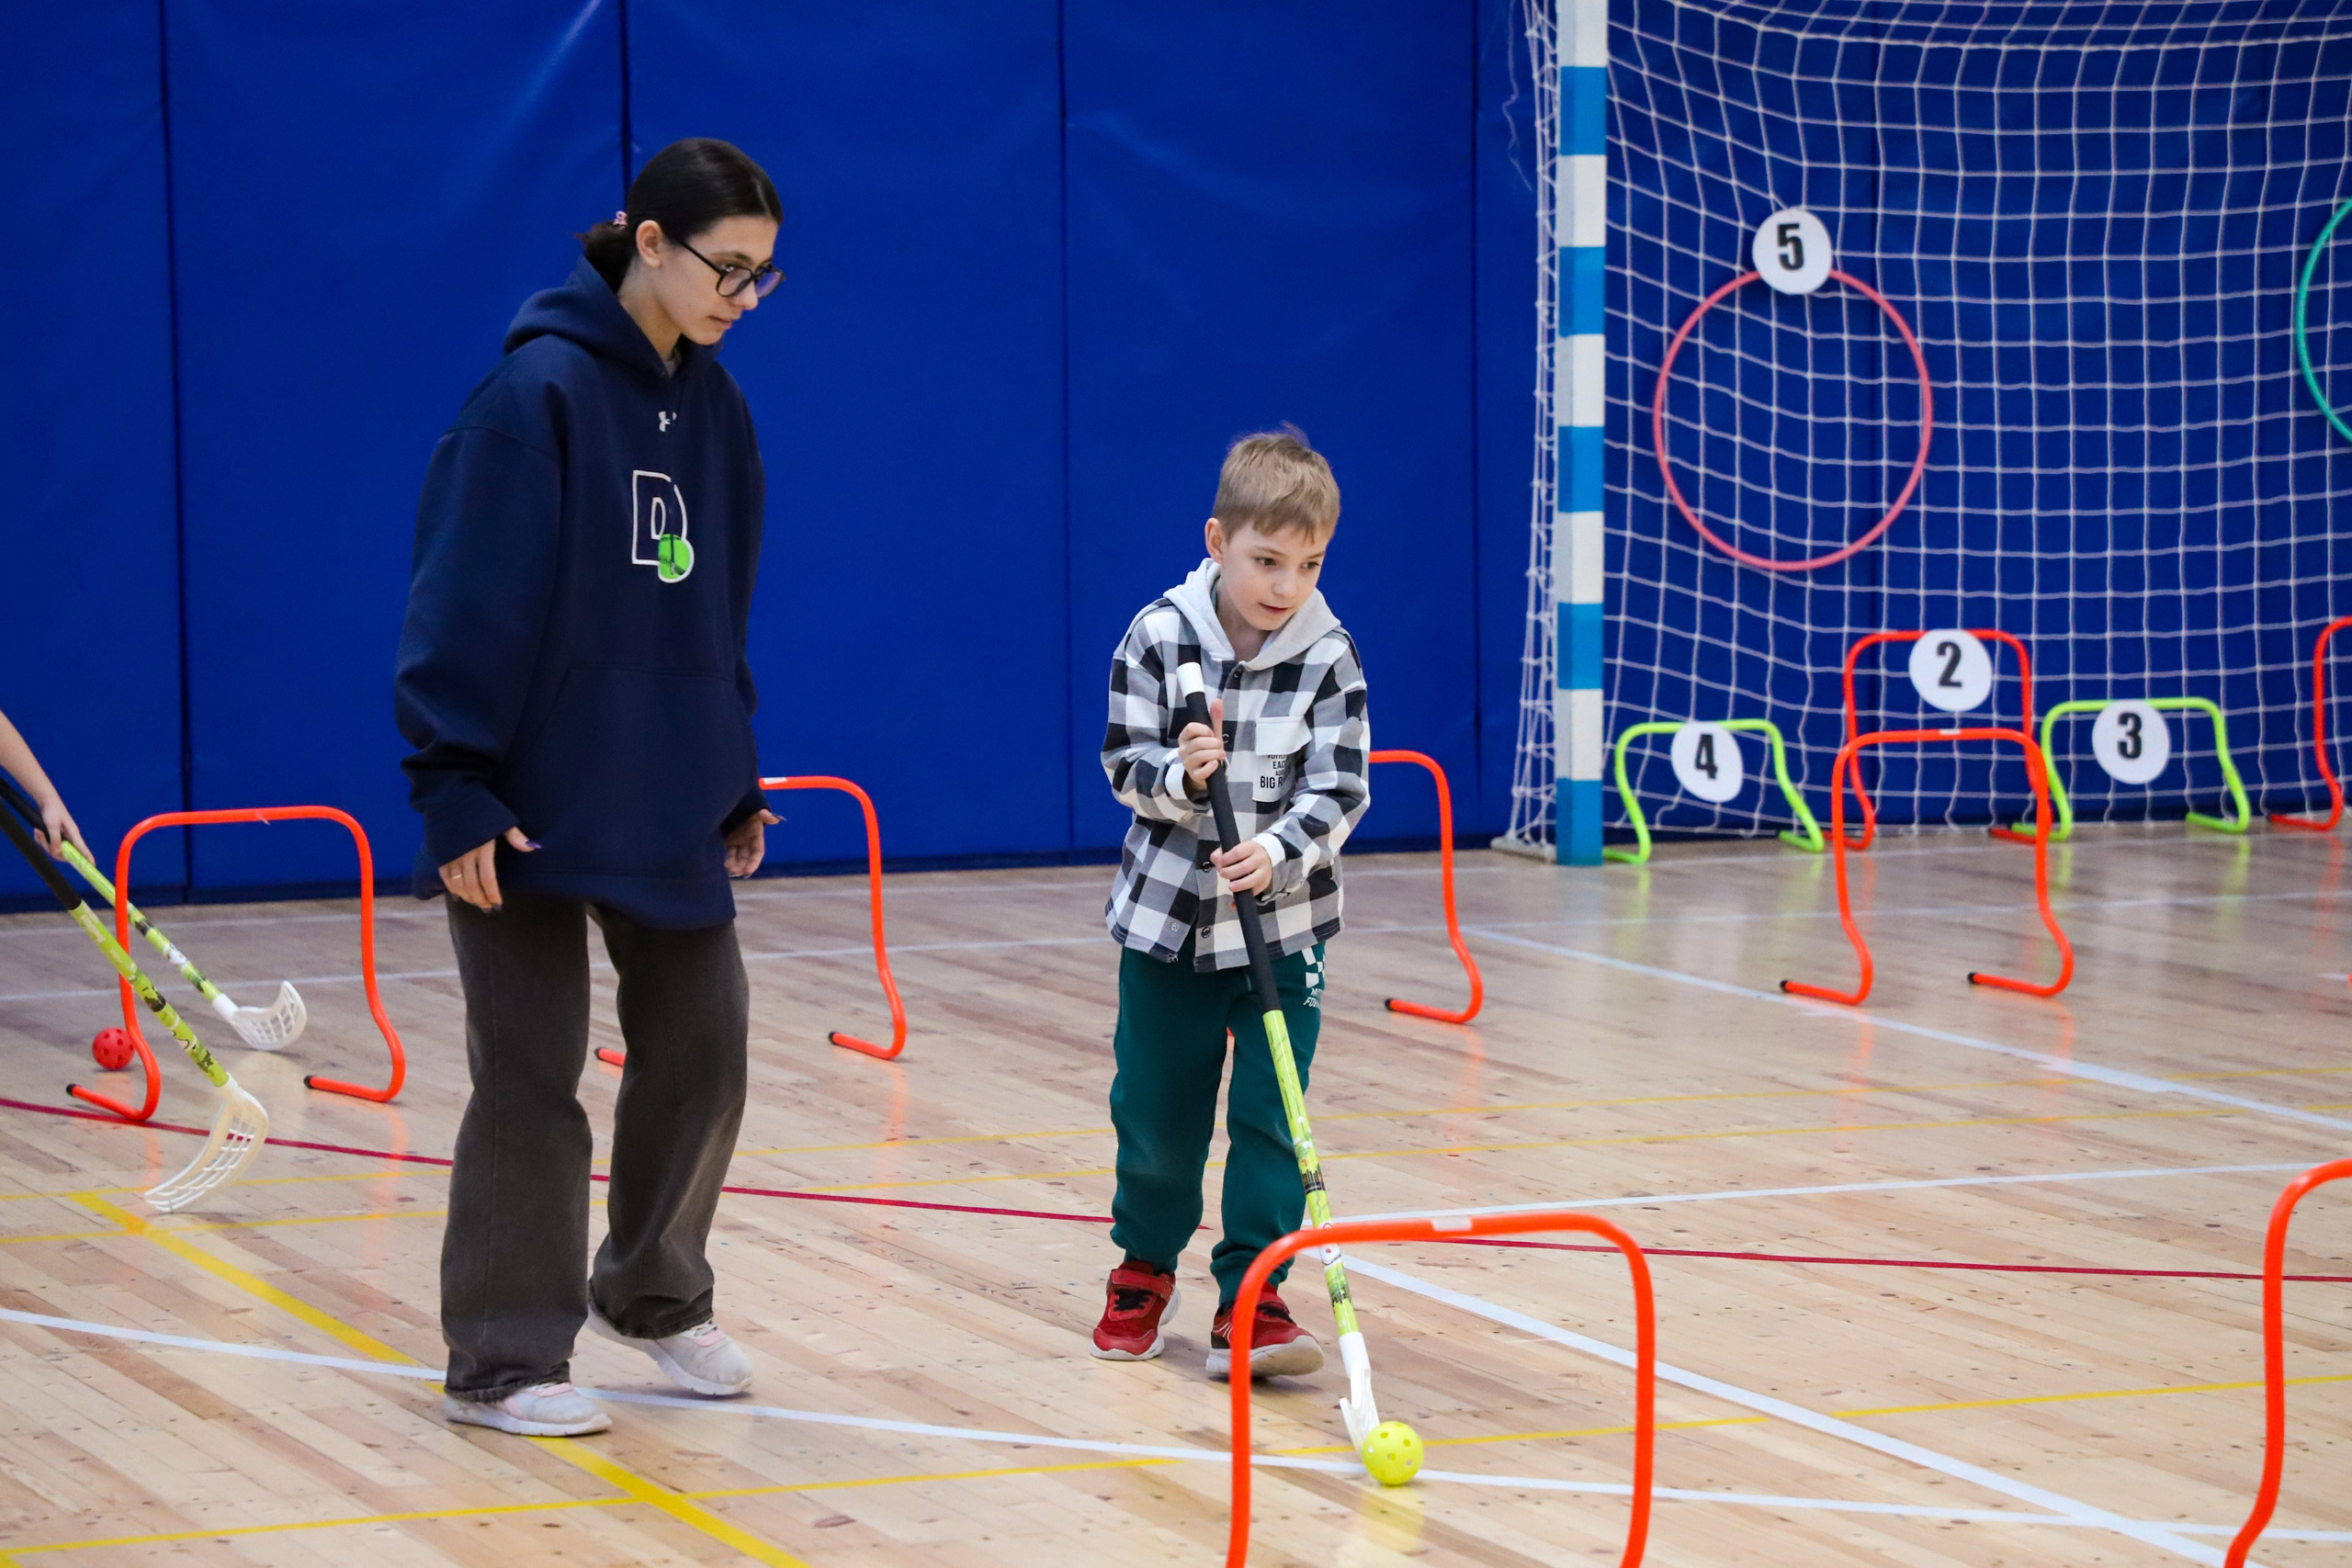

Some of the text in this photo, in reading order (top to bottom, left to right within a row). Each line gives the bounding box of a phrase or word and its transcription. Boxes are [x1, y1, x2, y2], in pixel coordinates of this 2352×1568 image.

[1777, 223, 1804, 270] 5
[1937, 641, 1962, 688] 2
[1694, 734, 1718, 779] 4
[2117, 712, 2143, 760] 3
[1260, 775, 1275, 789] BIG
